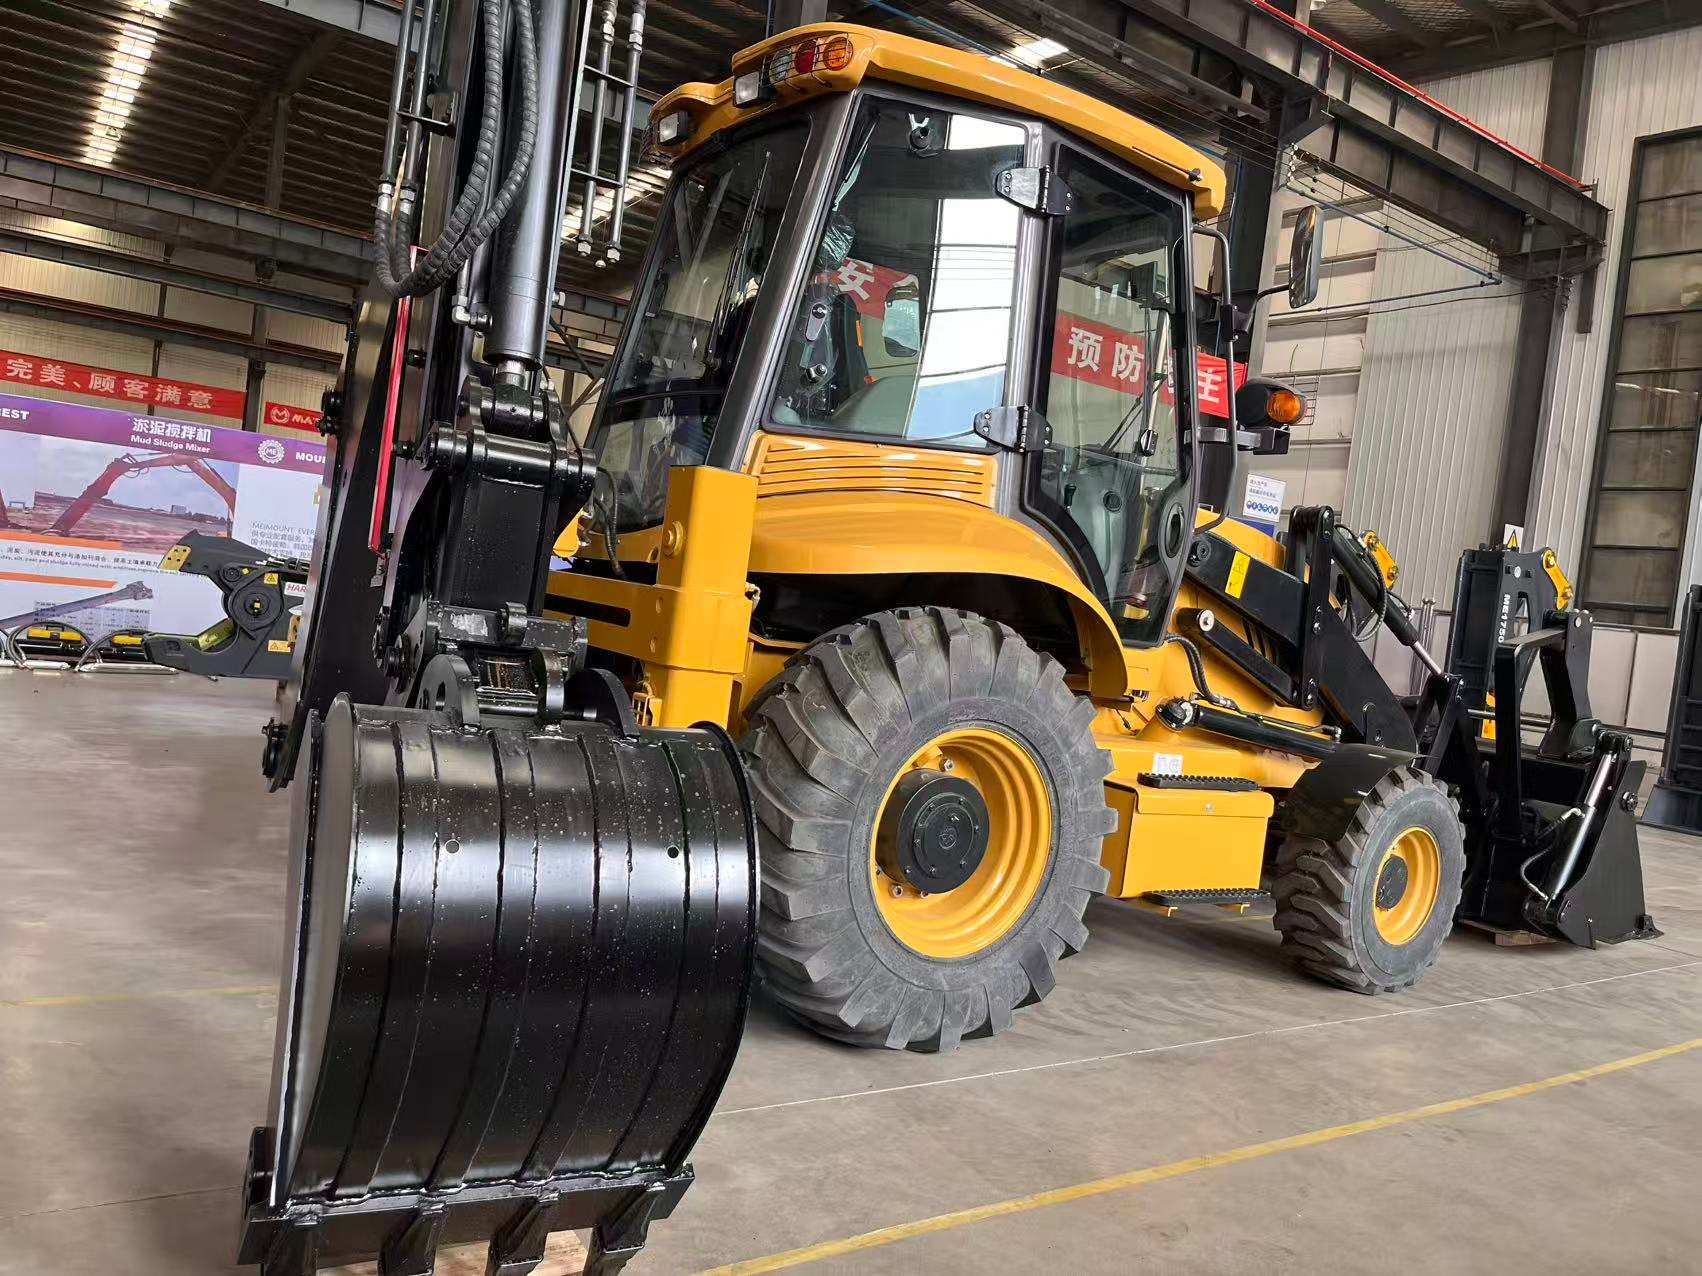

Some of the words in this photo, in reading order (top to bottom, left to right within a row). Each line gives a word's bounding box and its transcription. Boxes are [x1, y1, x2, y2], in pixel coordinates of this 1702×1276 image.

[6, 358, 213, 408] 完美、顾客满意
[0, 407, 30, 420] EST
[132, 418, 212, 443] 淤泥搅拌机
[131, 434, 151, 445] Mud
[153, 438, 184, 450] Sludge
[185, 443, 211, 454] Mixer
